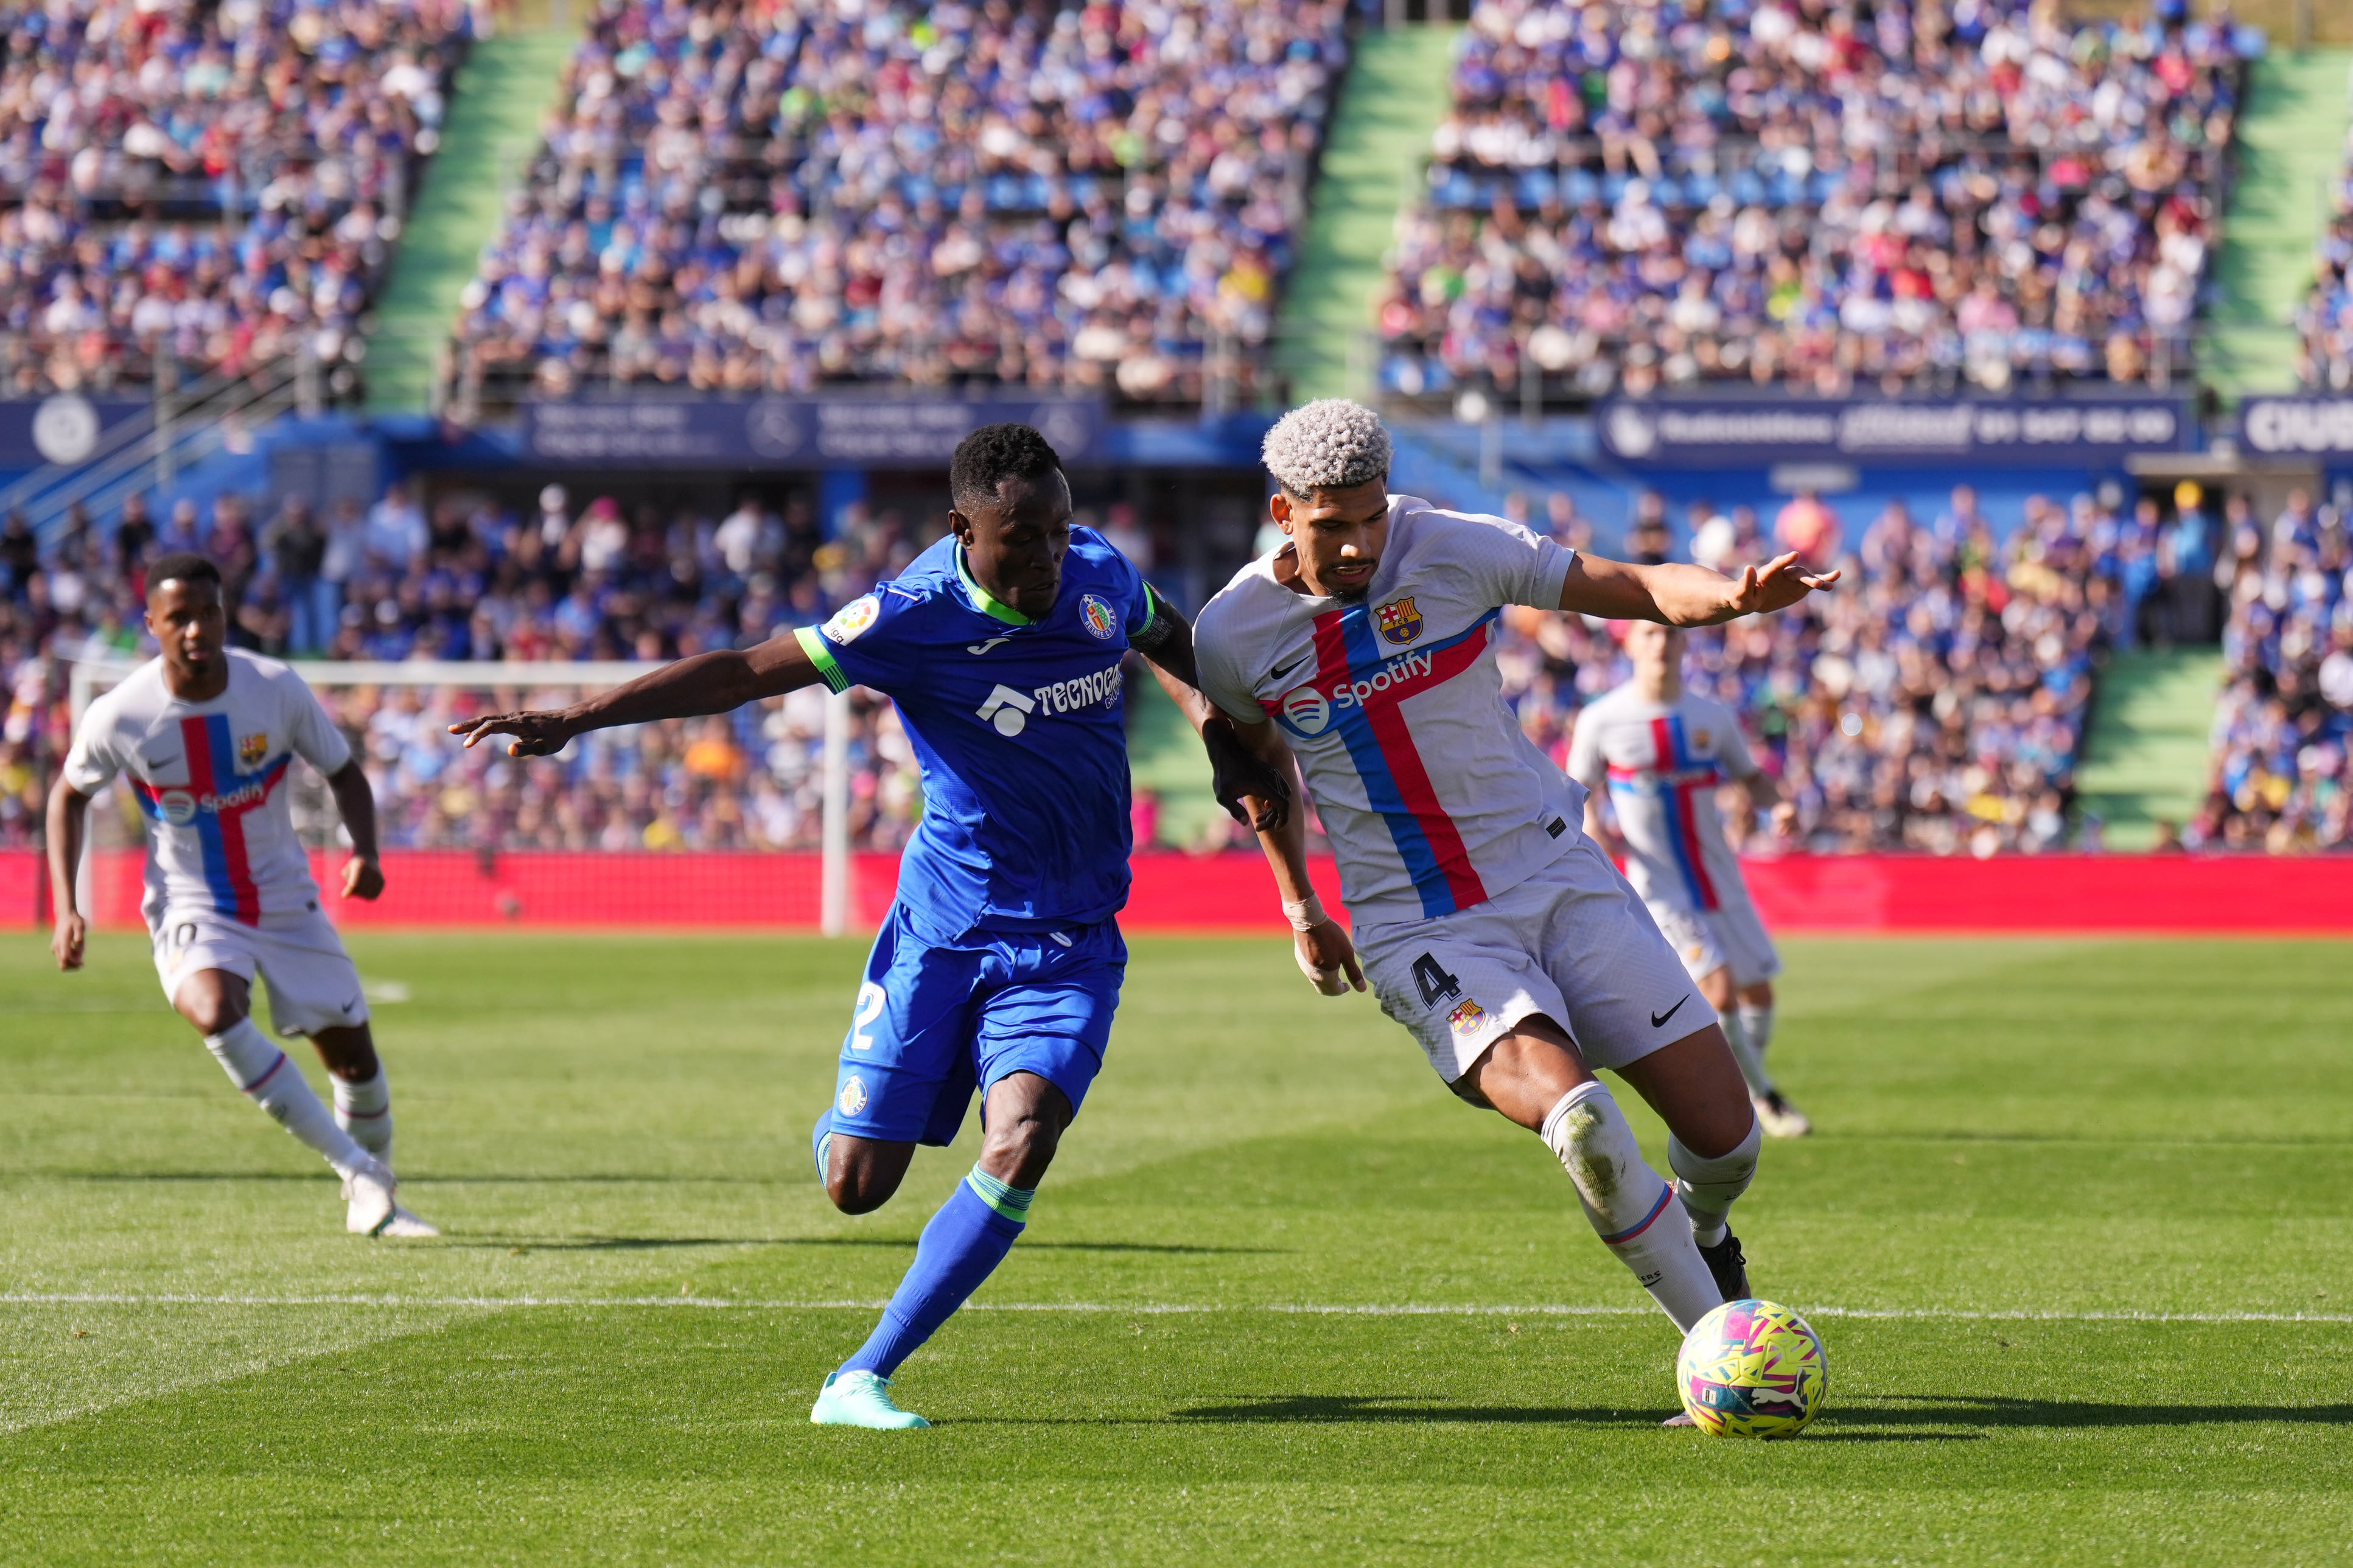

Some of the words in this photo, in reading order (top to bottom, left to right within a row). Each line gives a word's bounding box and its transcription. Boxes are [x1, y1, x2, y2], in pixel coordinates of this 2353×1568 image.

[1085, 621, 1104, 638] GETAFE
[1392, 617, 1408, 627] FCB
[1105, 685, 1119, 709] GROU
[1333, 649, 1432, 709] Spotify
[1410, 952, 1462, 1011] 4
[851, 981, 887, 1050] 2
